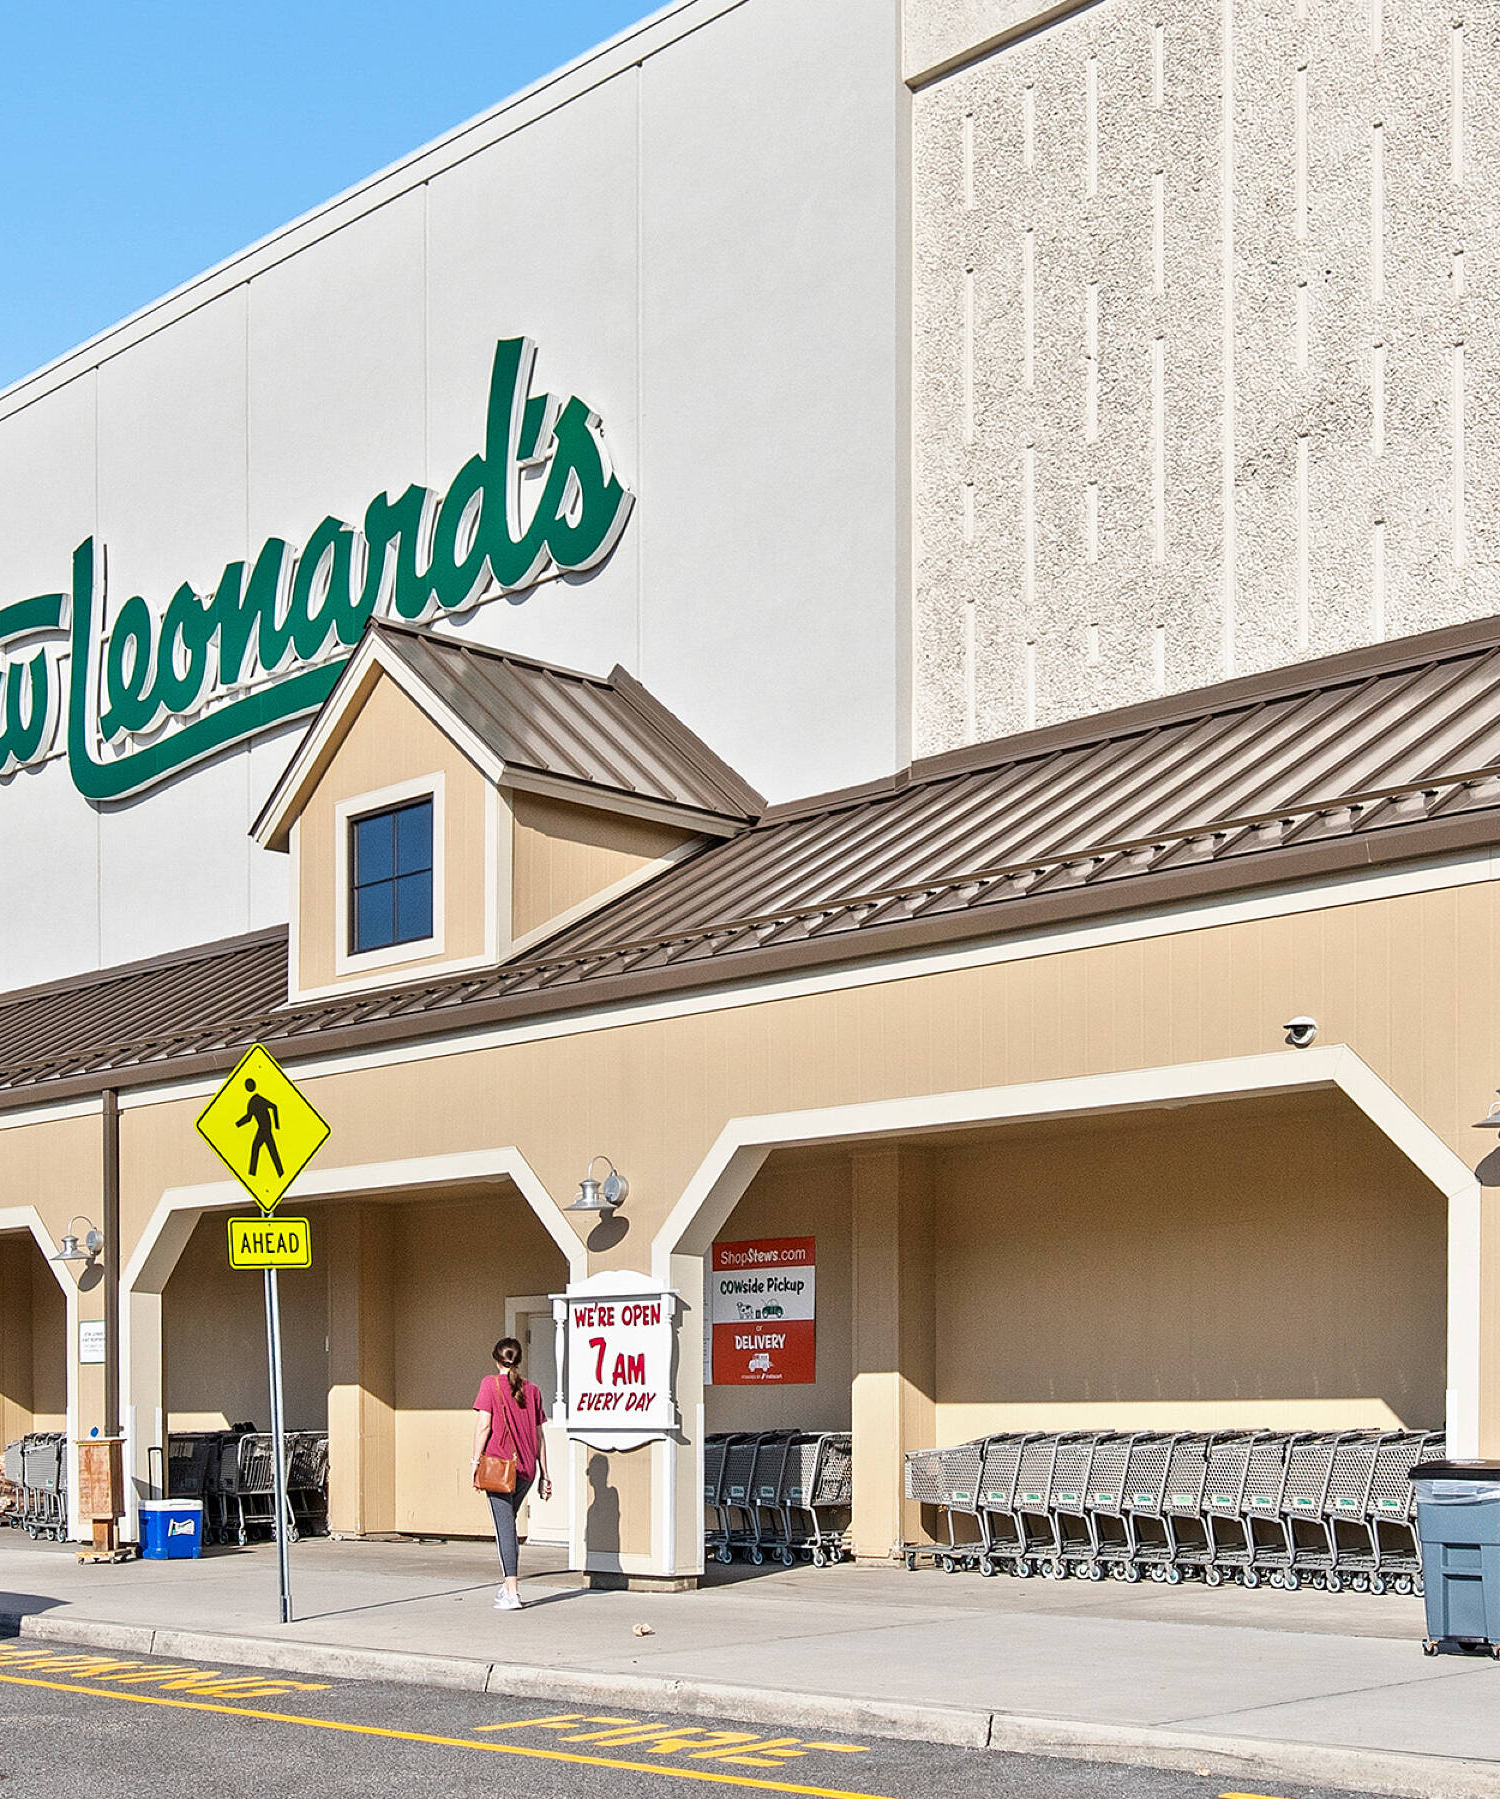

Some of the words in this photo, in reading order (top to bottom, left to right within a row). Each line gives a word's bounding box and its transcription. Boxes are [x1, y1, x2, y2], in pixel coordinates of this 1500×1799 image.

[67, 335, 636, 802] Leonard's
[240, 1232, 300, 1254] AHEAD
[720, 1248, 806, 1266] ShopStews.com
[720, 1278, 764, 1295] COWside
[766, 1276, 805, 1295] Pickup
[574, 1301, 615, 1328] WE'RE
[621, 1303, 661, 1327] OPEN
[734, 1333, 786, 1350] DELIVERY
[588, 1337, 607, 1385] 7
[612, 1352, 646, 1387] AM
[577, 1392, 625, 1412] EVERY
[624, 1392, 657, 1412] DAY
[472, 1713, 871, 1768] FIRE
